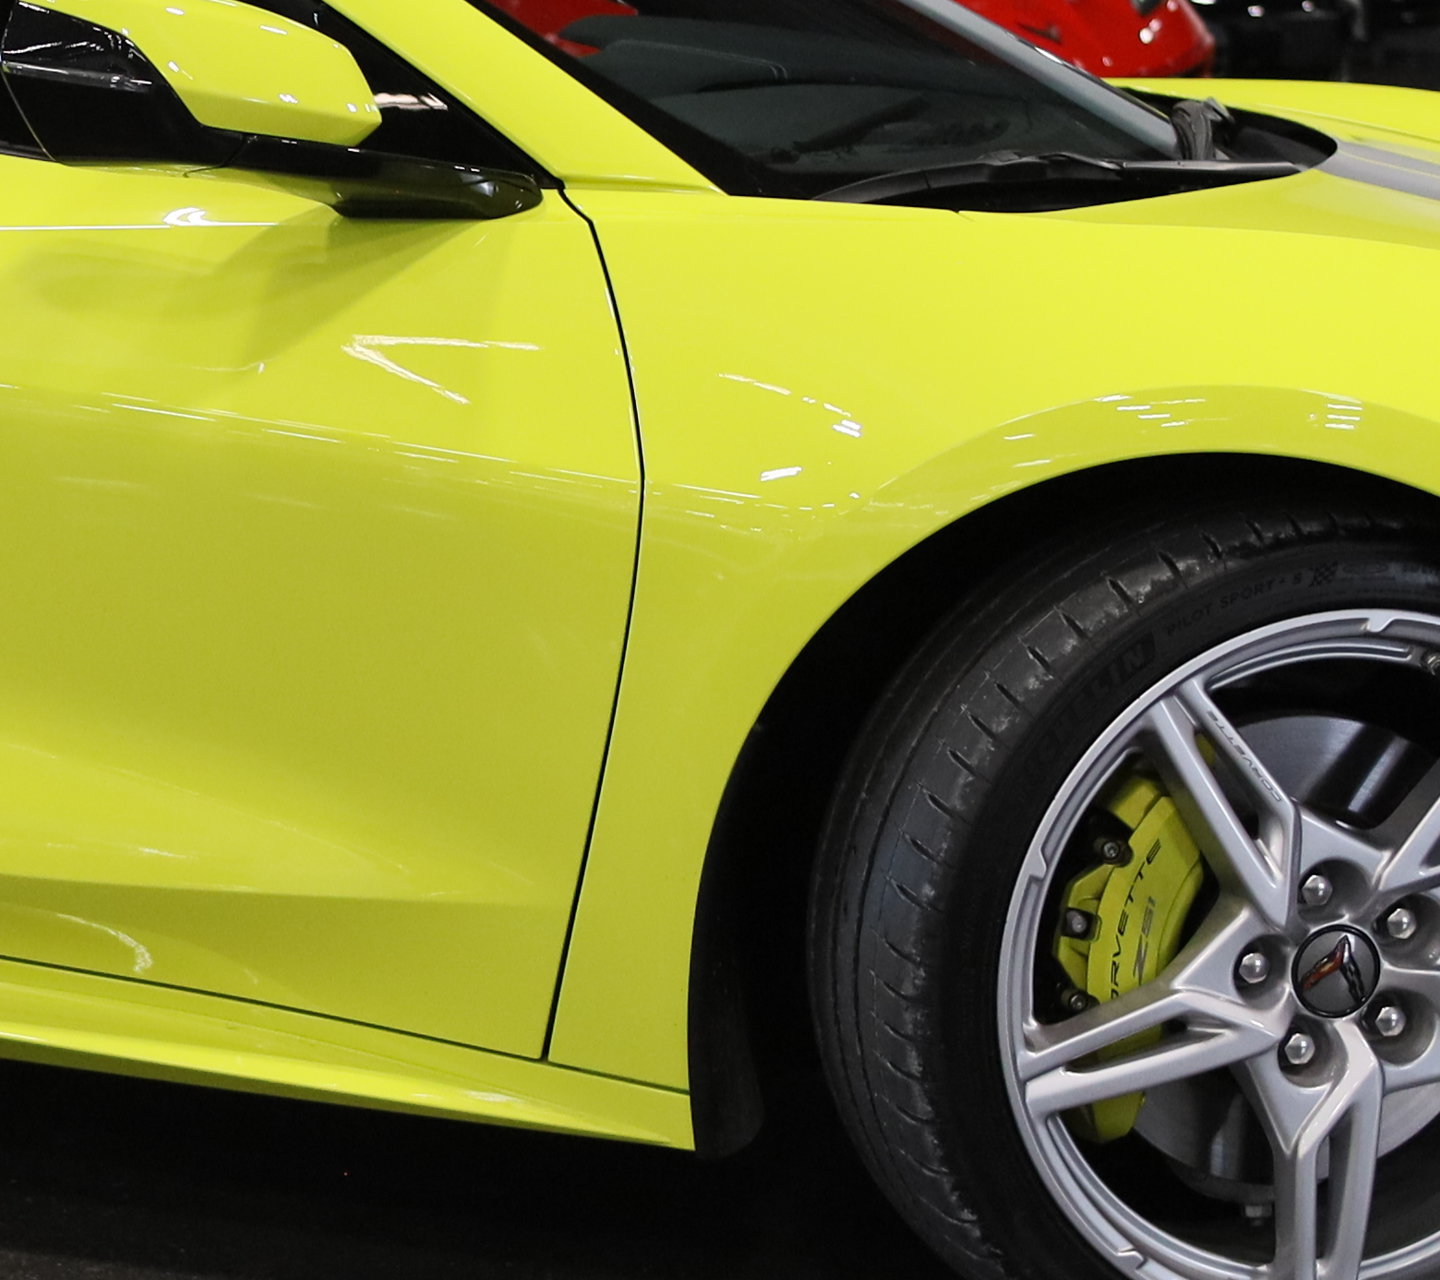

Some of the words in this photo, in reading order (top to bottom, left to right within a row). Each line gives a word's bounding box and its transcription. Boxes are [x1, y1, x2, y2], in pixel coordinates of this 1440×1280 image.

[1166, 601, 1213, 637] PILOT
[1219, 578, 1275, 609] SPORT
[1206, 710, 1282, 802] CORVETTE
[1110, 837, 1162, 1001] RVETTE
[1132, 895, 1156, 987] Z51
